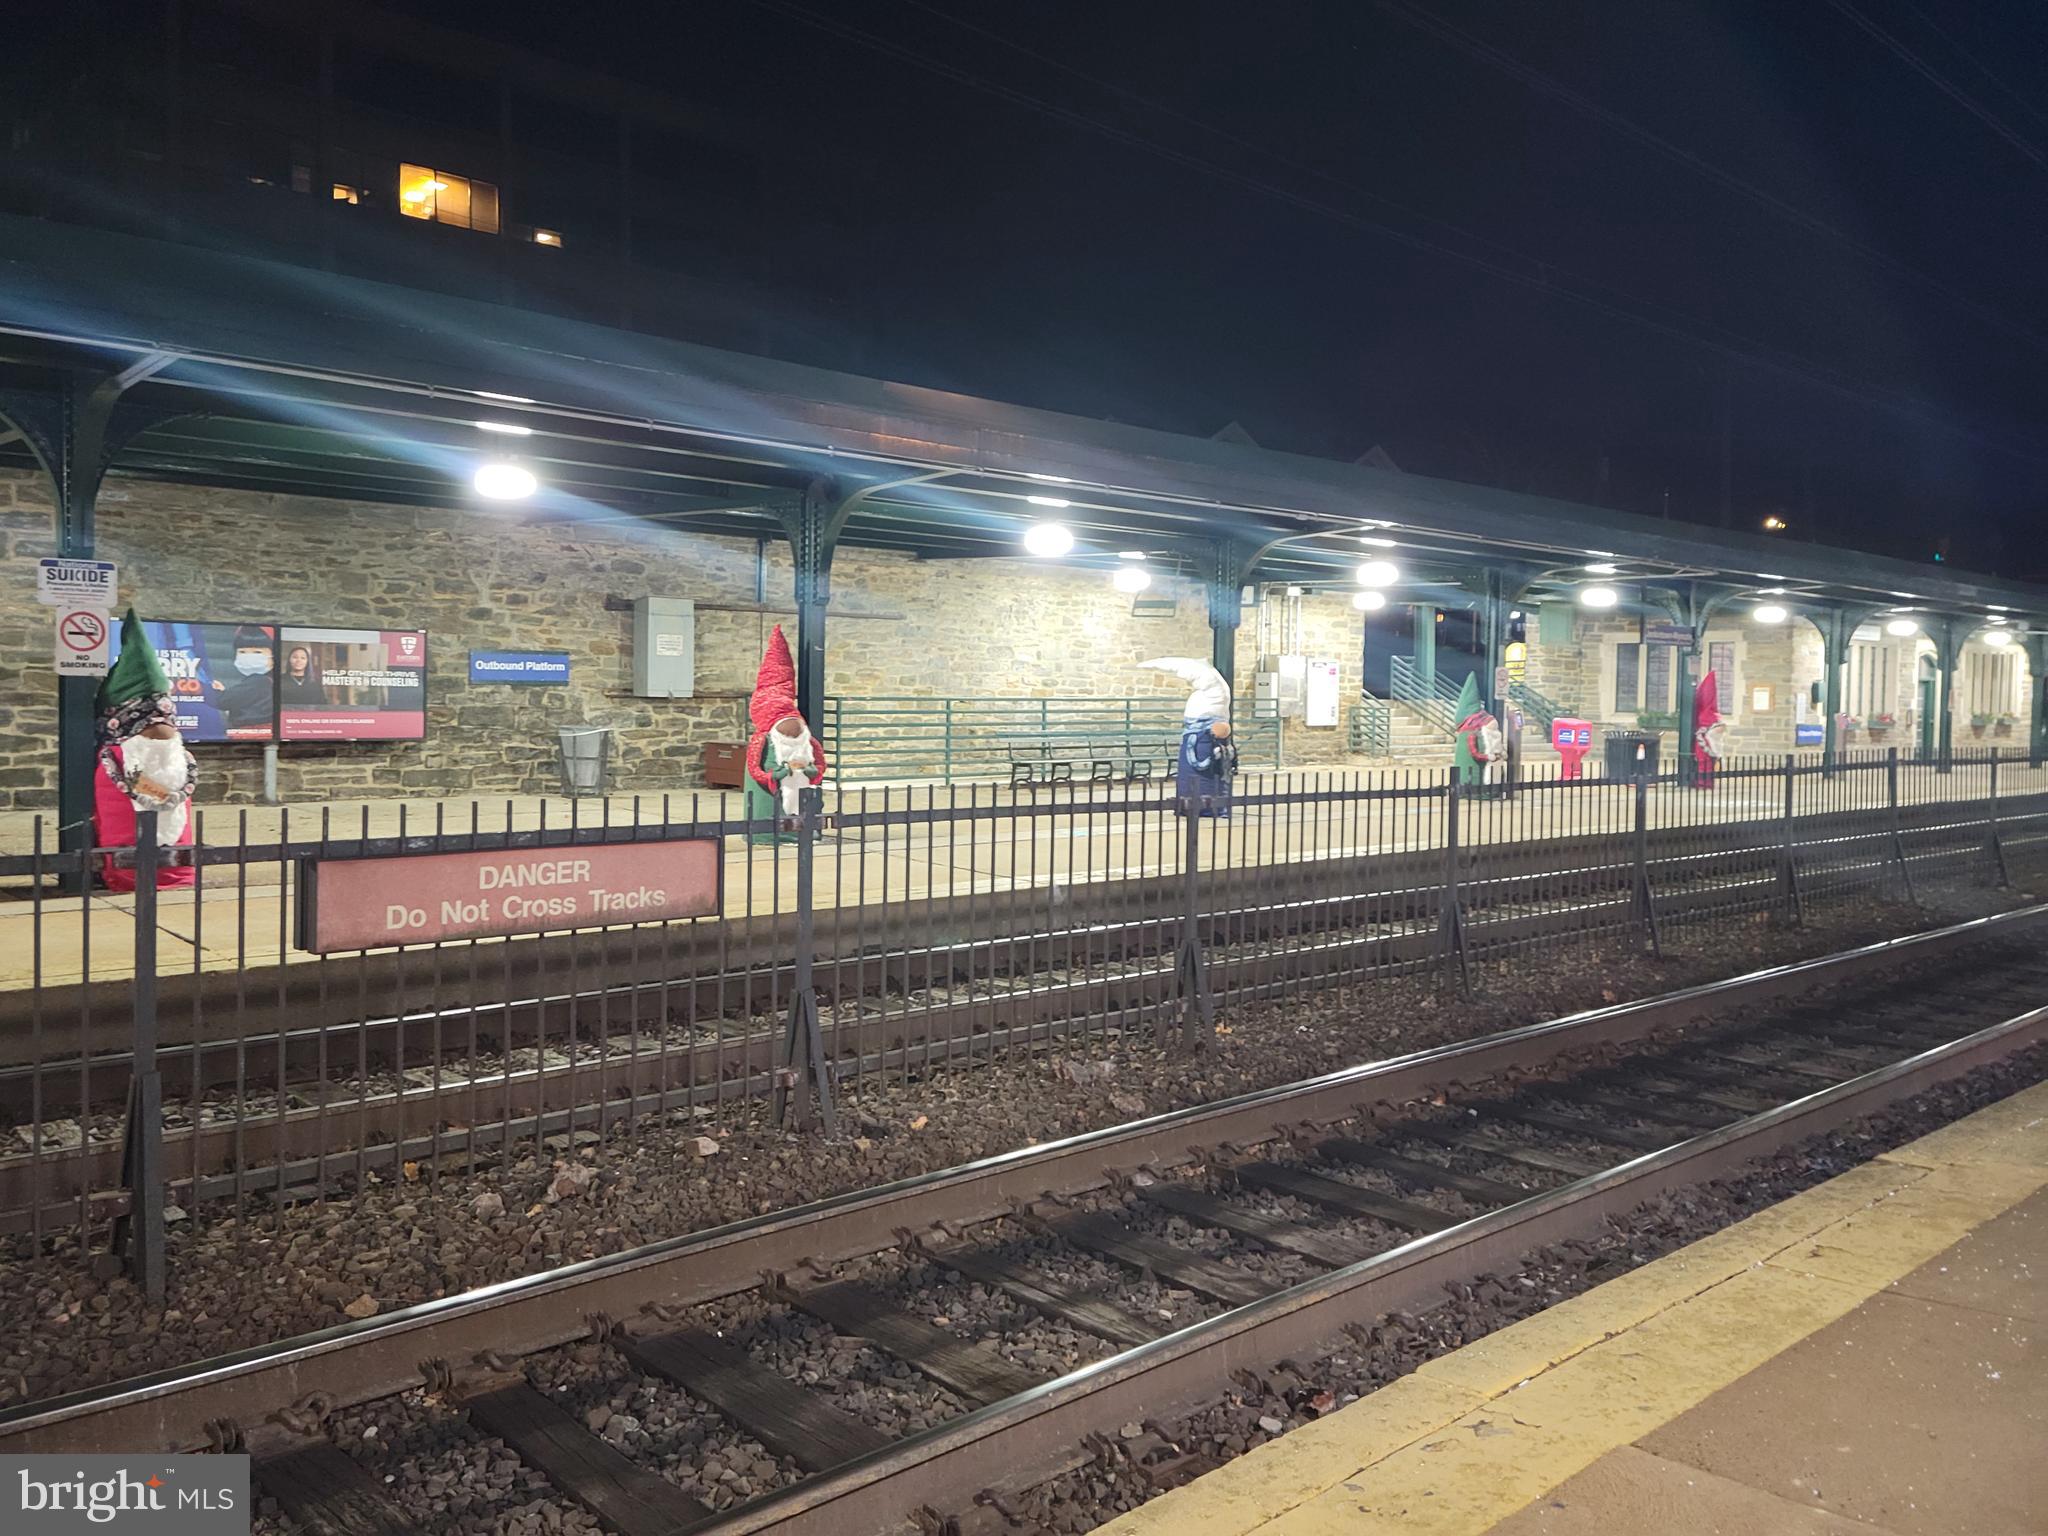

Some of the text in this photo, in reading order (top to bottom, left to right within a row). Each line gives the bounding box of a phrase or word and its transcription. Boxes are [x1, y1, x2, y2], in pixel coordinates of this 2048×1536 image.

[46, 568, 109, 583] SUICIDE
[60, 661, 106, 669] SMOKING
[475, 660, 565, 671] Outbound Platform
[176, 679, 201, 693] GO
[322, 676, 362, 686] MASTER'S
[371, 677, 419, 687] COUNSELING
[479, 860, 590, 890] DANGER
[386, 886, 666, 930] Do Not Cross Tracks
